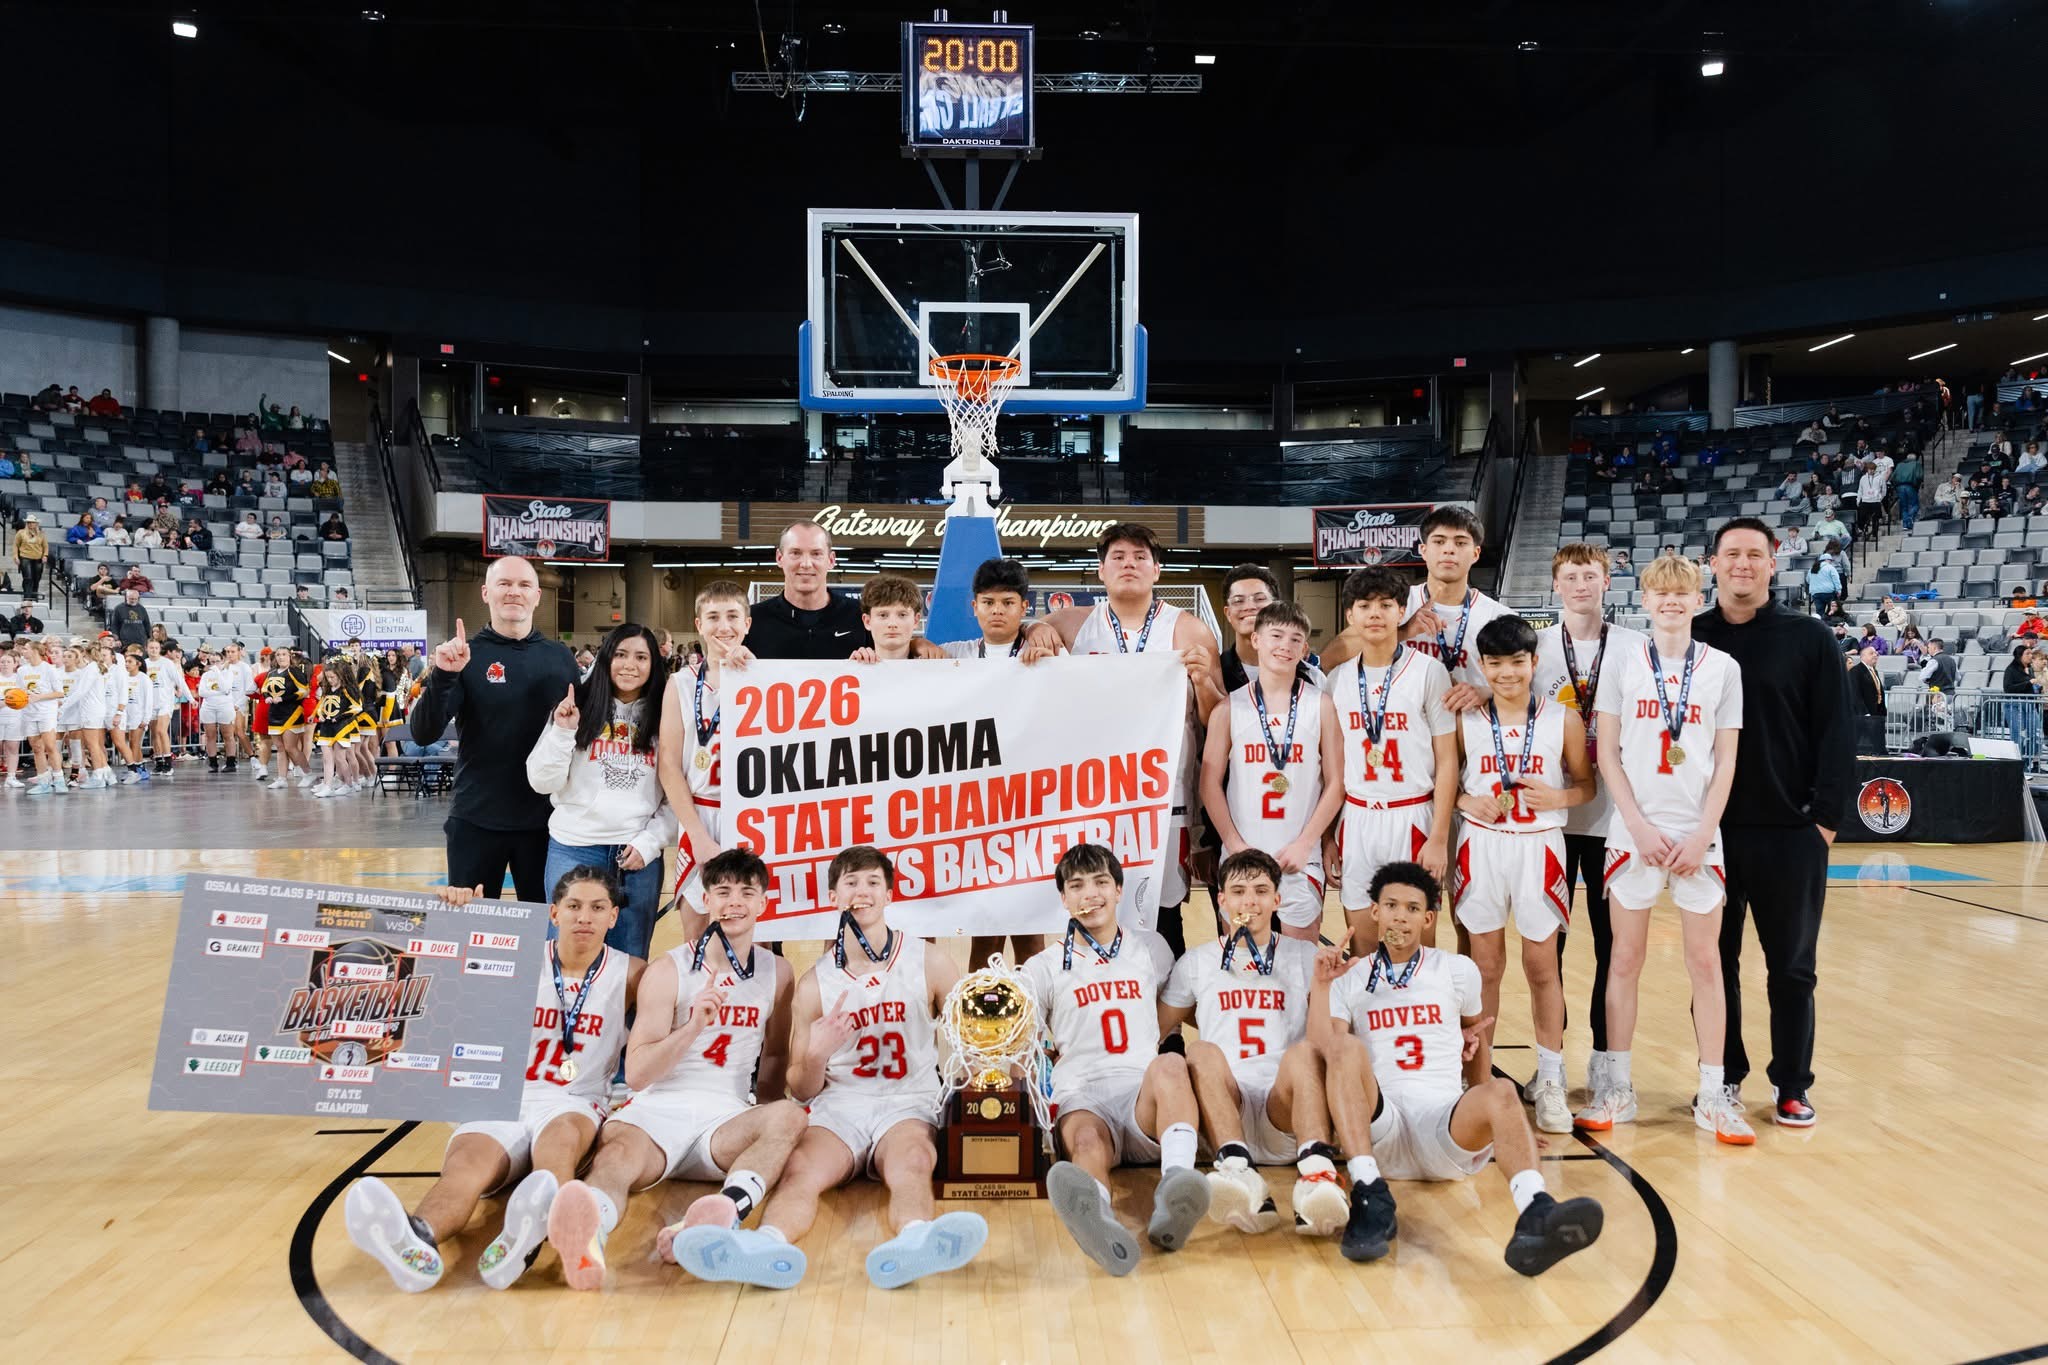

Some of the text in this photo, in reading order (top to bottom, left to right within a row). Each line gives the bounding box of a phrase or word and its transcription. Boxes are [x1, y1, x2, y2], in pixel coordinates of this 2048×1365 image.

[924, 39, 1018, 72] 20:00
[822, 390, 854, 398] SPALDING
[521, 500, 573, 522] State
[1347, 510, 1395, 532] State
[489, 517, 604, 552] CHAMPIONSHIPS
[811, 505, 1117, 547] Gateway o hampions
[1319, 526, 1421, 557] CHAMPIONSHIP
[375, 616, 404, 624] ORTHO
[1528, 621, 1553, 629] RMY
[1406, 640, 1468, 668] OVR
[1548, 675, 1567, 696] GOLD
[736, 675, 860, 737] 2026
[1636, 699, 1702, 725] DOR
[590, 737, 655, 767] DOVR
[737, 718, 1001, 798] OKLAHOMA
[1244, 743, 1303, 763] DOR
[1362, 738, 1404, 782] 14
[1657, 729, 1674, 774] 1
[737, 748, 1169, 857] STATE CHAMPIONS
[1262, 772, 1285, 819] 2
[204, 879, 532, 918] OSSAA 2026 CLASS B-II BOYS BASKETBALL STATE TOURNAMENT
[766, 863, 815, 915] -II
[234, 915, 263, 924] DOVER
[321, 908, 372, 920] THE ROAD
[321, 918, 367, 928] TO STATE
[386, 918, 414, 931] wsb
[226, 943, 261, 954] GRANITE
[297, 933, 325, 943] DOVER
[430, 943, 456, 954] DUKE
[491, 936, 517, 947] DUKE
[355, 966, 383, 977] DOVER
[483, 963, 514, 972] BATTIEST
[280, 975, 433, 1032] BASKETBALL
[1074, 980, 1142, 1008] DOVER
[1218, 989, 1286, 1012] DOVER
[690, 1006, 760, 1028] VER
[850, 1002, 906, 1031] DOVER
[1367, 1004, 1442, 1031] DOVER
[215, 1033, 244, 1043] ASHER
[355, 1023, 382, 1034] DUKE
[1101, 1009, 1129, 1054] 0
[1238, 1018, 1266, 1059] 5
[274, 1049, 310, 1061] LEEDEY
[703, 1033, 732, 1067] 4
[852, 1032, 908, 1080] 23
[1394, 1035, 1425, 1071] 3
[204, 1061, 241, 1072] LEEDEY
[525, 1038, 585, 1086] 15
[341, 1069, 369, 1078] DOVER
[327, 1088, 362, 1099] STATE
[315, 1102, 369, 1113] CHAMPION
[966, 1103, 1016, 1114] 20 26
[951, 1190, 1030, 1198] STATE CHAMPION
